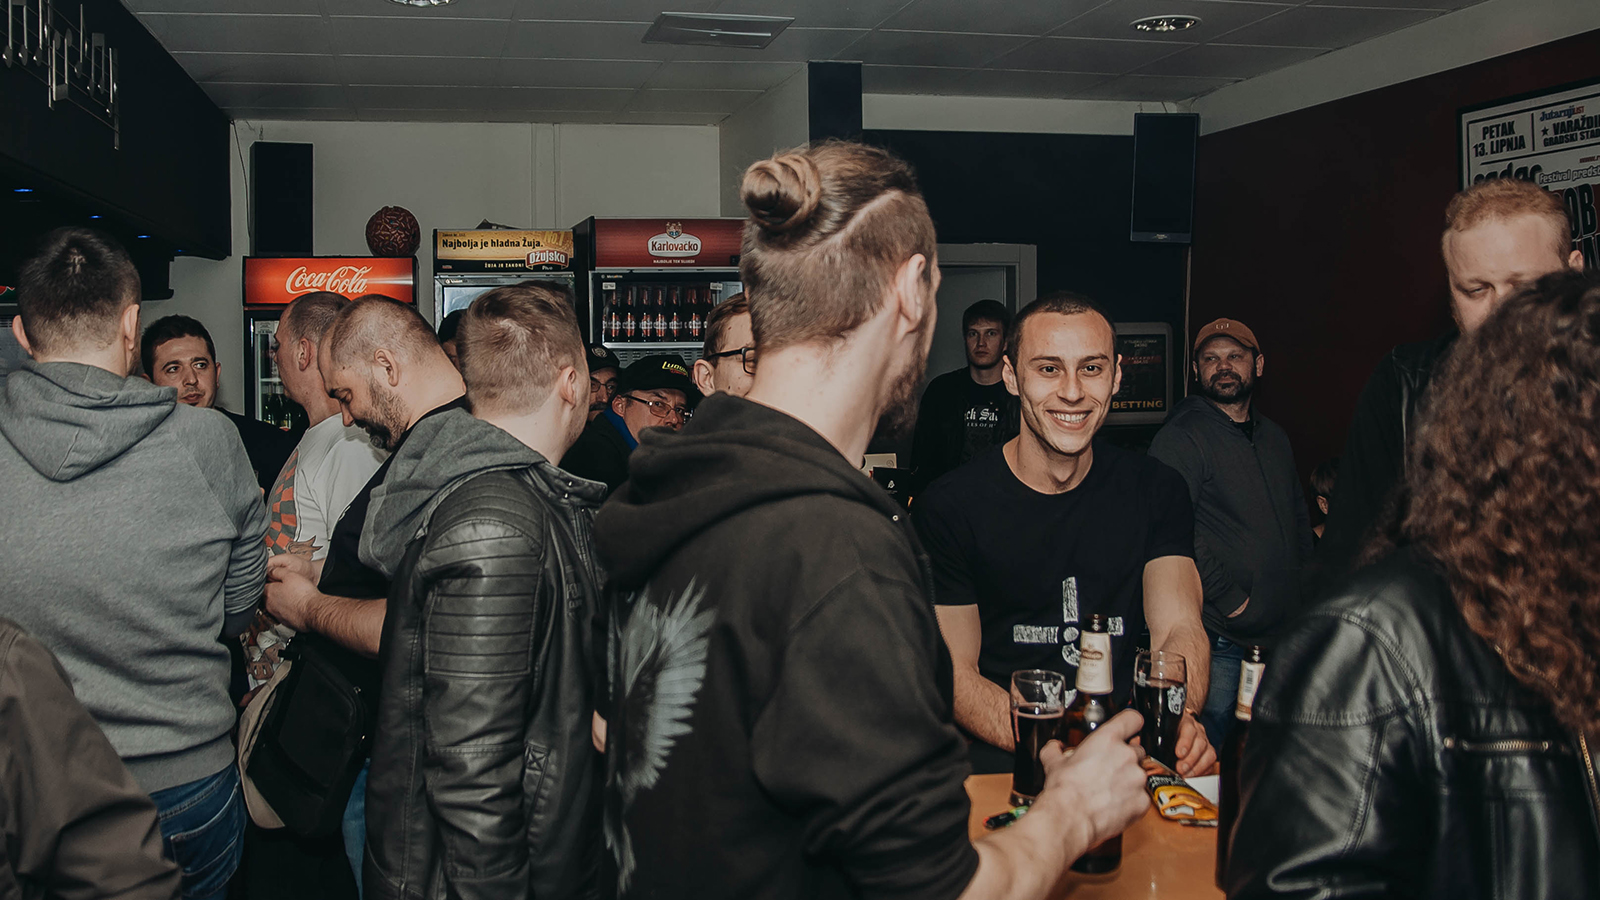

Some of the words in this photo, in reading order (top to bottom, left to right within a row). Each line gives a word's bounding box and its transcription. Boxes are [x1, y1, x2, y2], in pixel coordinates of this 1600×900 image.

[1482, 121, 1516, 140] PETAK
[1473, 142, 1489, 157] 13.
[1490, 135, 1526, 155] LIPNJA
[1543, 132, 1578, 147] GRADSKI
[442, 239, 478, 249] Najbolja
[480, 239, 488, 249] je
[491, 239, 520, 248] hladna
[522, 237, 544, 249] Žuja.
[651, 240, 699, 251] Karlovačko
[529, 250, 566, 264] Ožujsko
[286, 265, 373, 295] Coca-Cola
[1112, 400, 1164, 410] BETTING
